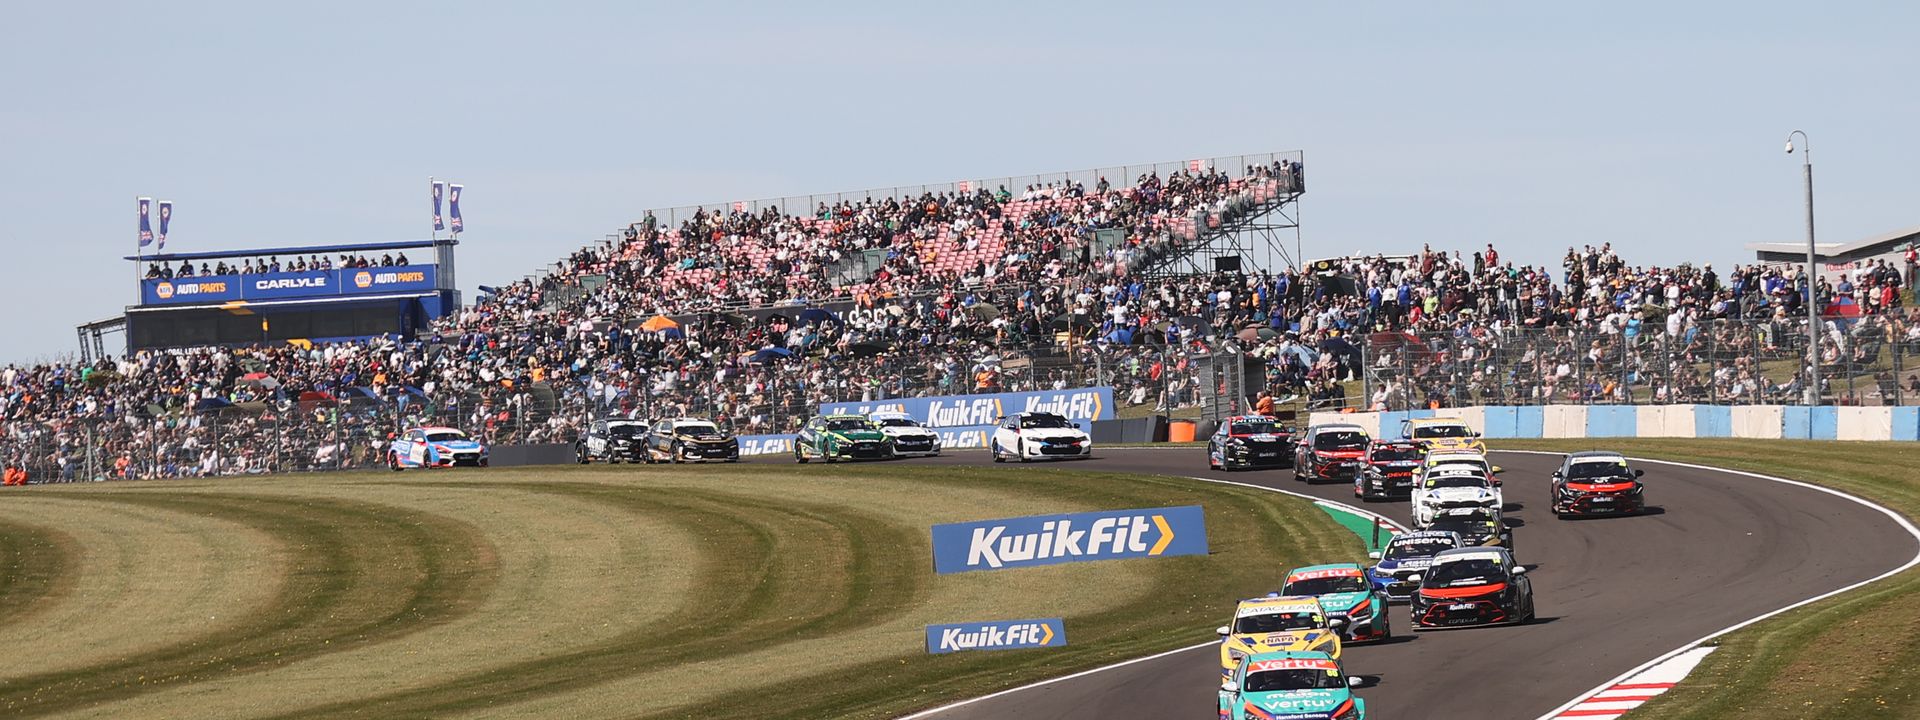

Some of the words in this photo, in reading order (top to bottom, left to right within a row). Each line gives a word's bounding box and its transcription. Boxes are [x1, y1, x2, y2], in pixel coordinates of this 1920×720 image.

[256, 277, 327, 290] CARLYLE
[375, 273, 397, 284] AUTO
[397, 272, 424, 282] PARTS
[177, 283, 199, 295] AUTO
[199, 282, 226, 293] PARTS
[927, 398, 994, 428] KwikFit
[1025, 392, 1093, 420] KwikFit
[967, 515, 1149, 568] KwikFit
[1241, 605, 1316, 615] CATACLEAN
[940, 624, 1041, 650] KwikFit
